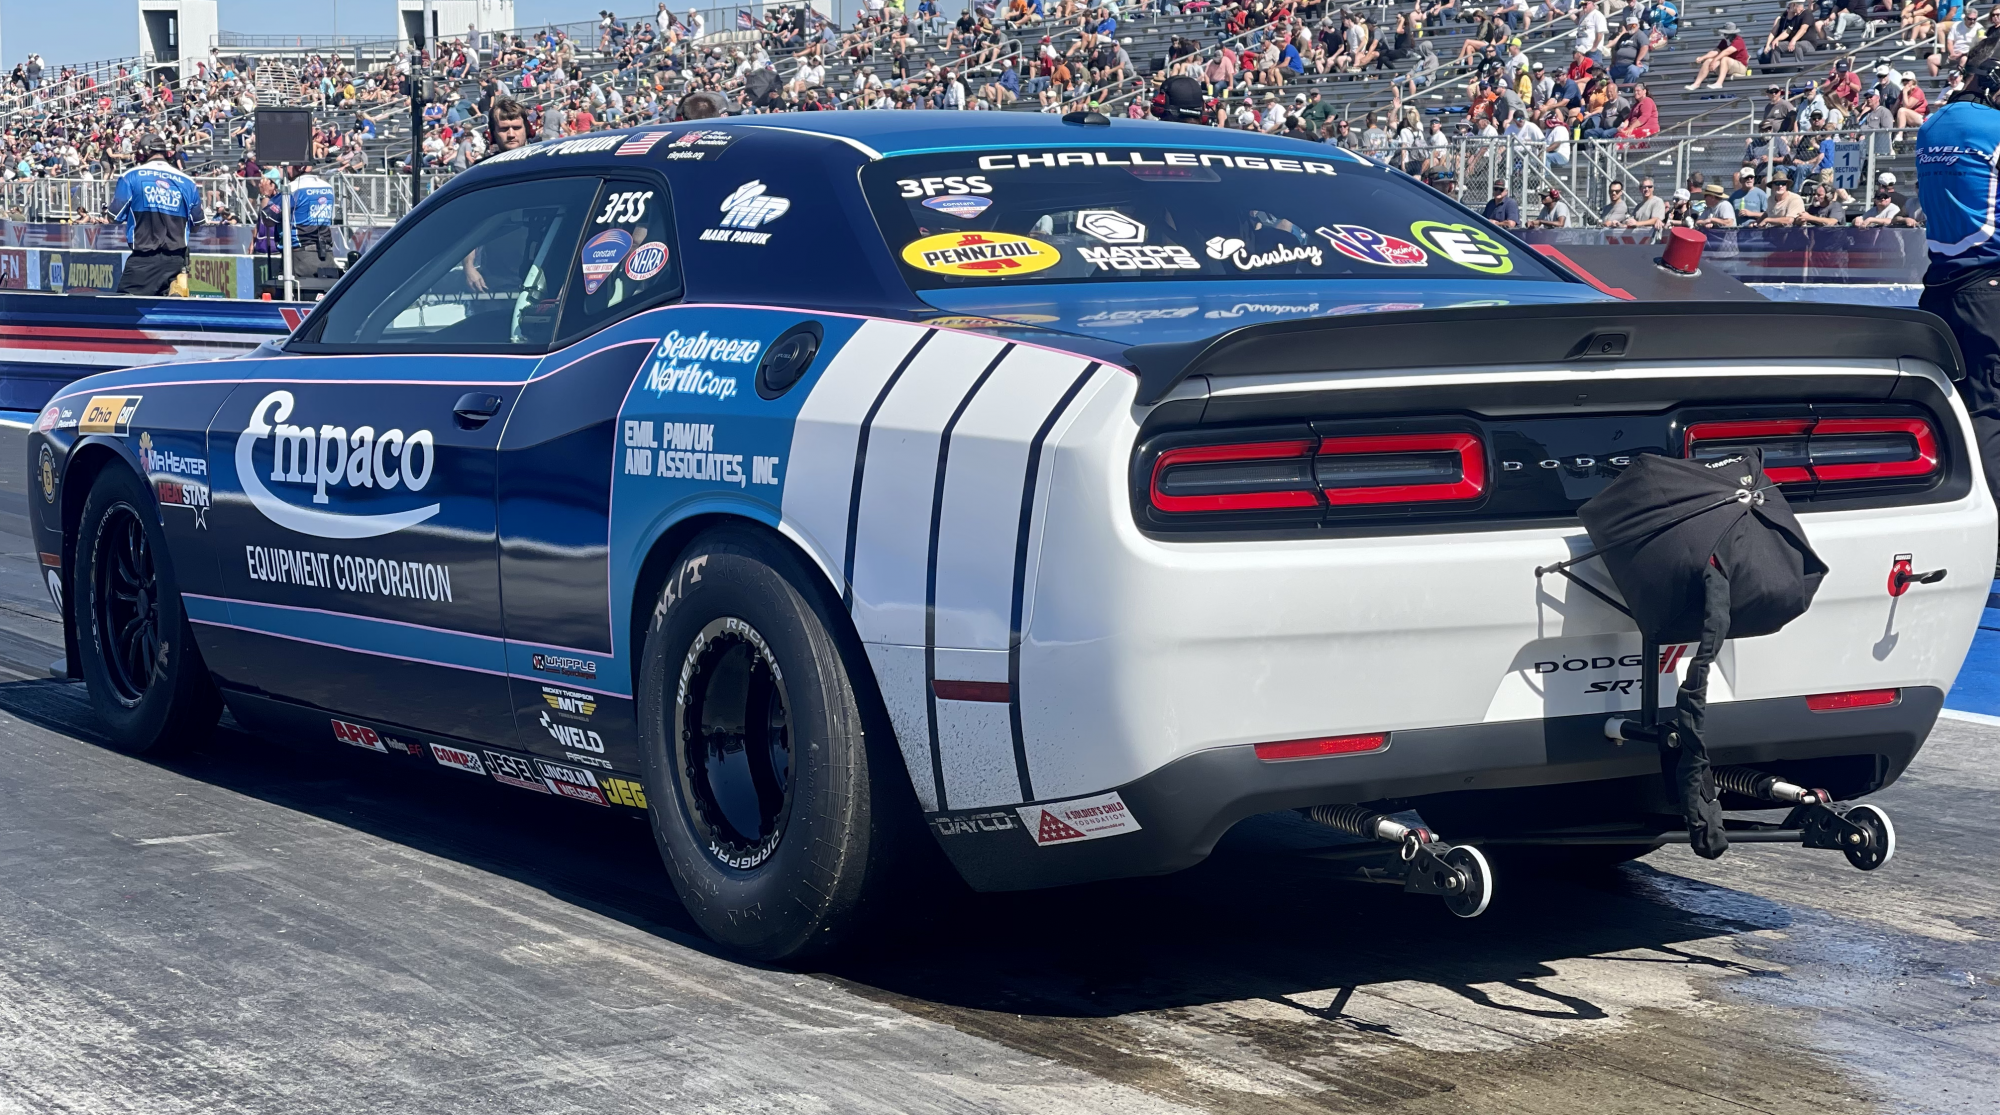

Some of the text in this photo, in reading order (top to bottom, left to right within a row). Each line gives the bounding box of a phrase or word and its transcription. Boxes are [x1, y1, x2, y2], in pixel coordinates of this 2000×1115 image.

[978, 152, 1337, 175] CHALLENGER
[1842, 152, 1850, 166] 1
[1919, 153, 1959, 166] Racing
[138, 170, 185, 184] OFFICIAL
[896, 175, 993, 198] 3FSS
[1836, 174, 1855, 188] 11
[145, 193, 180, 207] WORLD
[595, 190, 654, 224] 3FSS
[699, 228, 773, 245] MARK PAWUK
[593, 248, 617, 258] constant
[631, 248, 662, 274] NHRA
[923, 241, 1038, 267] PENNZOIL
[1076, 245, 1192, 259] MATCO
[1233, 243, 1323, 270] Cowboy
[1380, 244, 1419, 259] Racing
[1086, 256, 1201, 271] TOOLS
[68, 263, 114, 289] AUTO PARTS
[194, 259, 231, 299] SERVICE
[657, 328, 761, 364] Seabreeze
[88, 406, 113, 423] Ohio
[117, 406, 134, 424] CAT
[624, 420, 715, 451] EMIL PAWUK
[235, 390, 440, 539] Empaco
[624, 449, 779, 488] AND ASSOCIATES, INC
[1503, 456, 1631, 471] DODG
[246, 545, 453, 603] EQUIPMENT CORPORATION
[655, 554, 709, 633] M/T
[726, 616, 783, 681] RACING
[544, 655, 597, 673] WHIPPLE
[676, 632, 705, 706] WELD
[1534, 654, 1658, 674] DODG
[542, 686, 594, 701] MICKEY THOMPSON
[557, 696, 585, 714] M/T
[331, 720, 379, 747] ARP
[553, 723, 605, 754] WELD
[433, 746, 470, 766] COMP
[483, 750, 543, 784] JESEL
[565, 751, 613, 770] RACING
[537, 762, 590, 787] LINCOLN
[558, 783, 603, 804] WELDERS
[605, 777, 648, 809] JEG
[1065, 801, 1125, 821] A SOLDIER'S CHILD
[1074, 813, 1126, 827] FOUNDATION
[934, 811, 1013, 836] DAYCO
[708, 830, 780, 870] DRAGPAK
